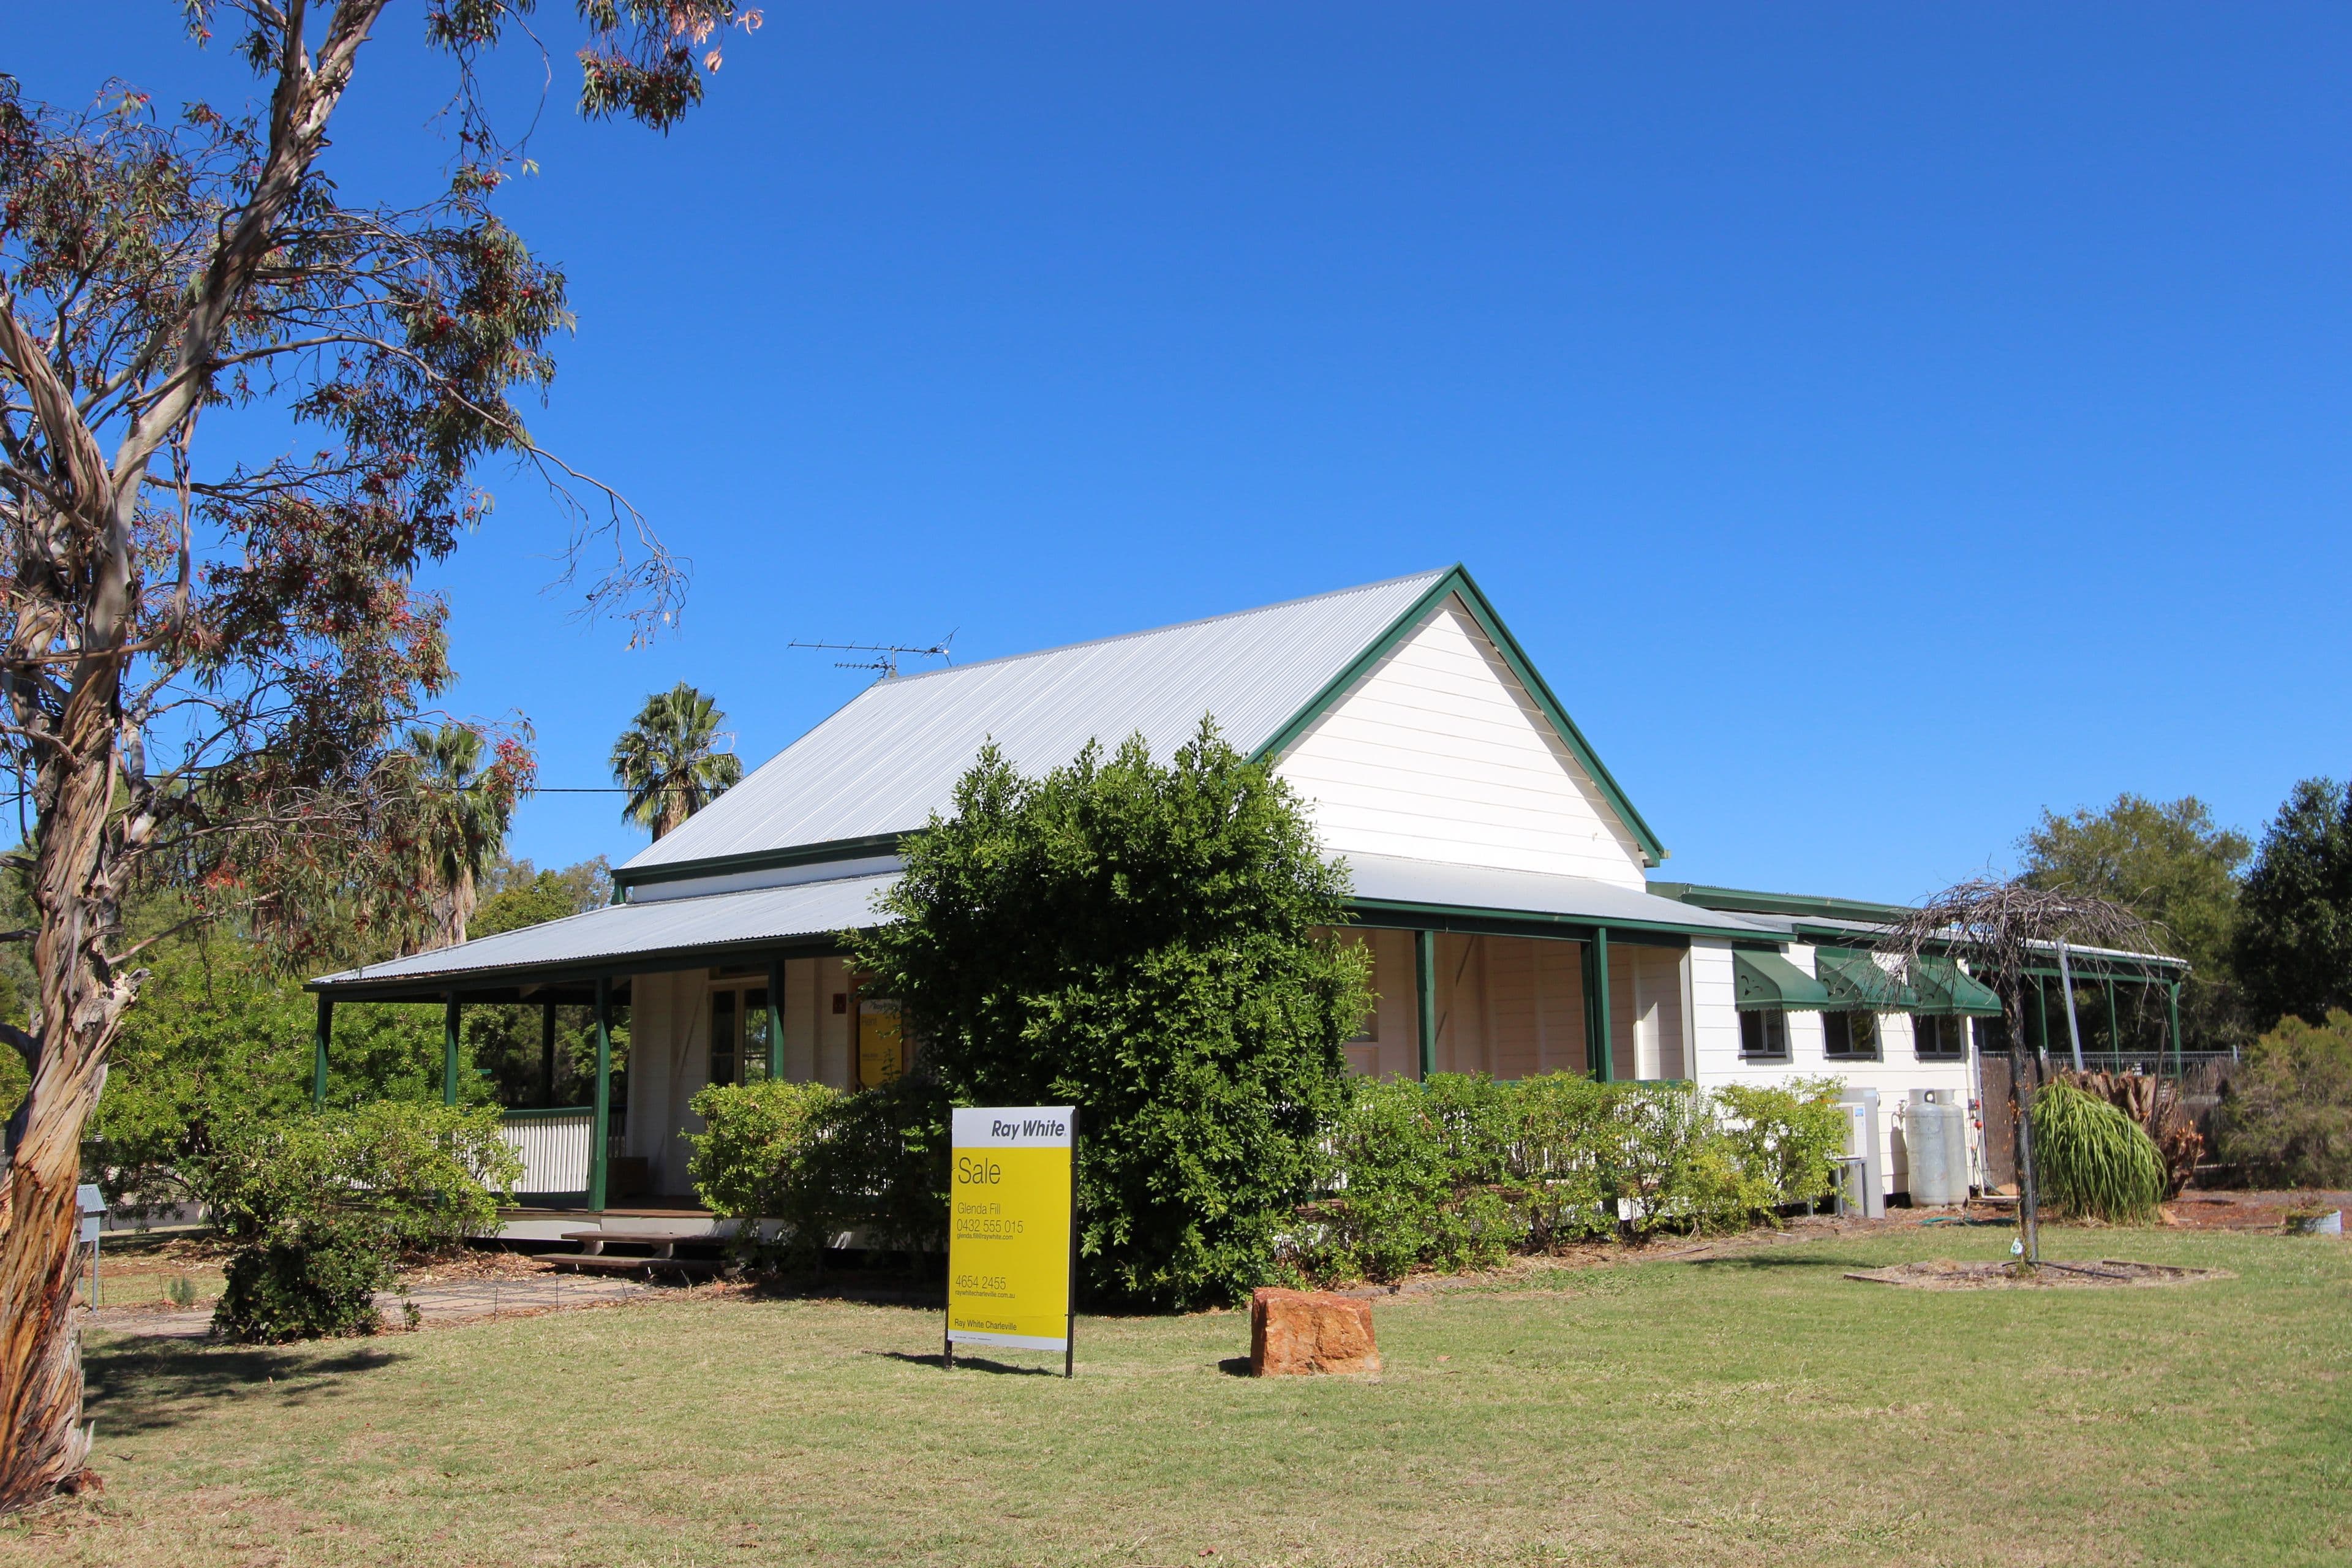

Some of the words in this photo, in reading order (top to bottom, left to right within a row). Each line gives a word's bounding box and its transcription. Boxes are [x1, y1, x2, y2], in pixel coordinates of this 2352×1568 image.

[992, 1120, 1020, 1140] Ray
[1023, 1120, 1065, 1136] White
[958, 1157, 1000, 1184] Sale
[957, 1202, 987, 1214] Glenda
[990, 1203, 1001, 1215] Fill
[957, 1219, 980, 1232] 0432
[983, 1219, 1001, 1232] 555
[1005, 1220, 1023, 1233] 015
[956, 1275, 979, 1288] 4654
[982, 1276, 1006, 1290] 2455
[955, 1290, 1016, 1298] raywhitecharleville.com.au
[954, 1318, 966, 1329] Ray
[967, 1319, 984, 1328] White
[986, 1321, 1017, 1330] Charleville
